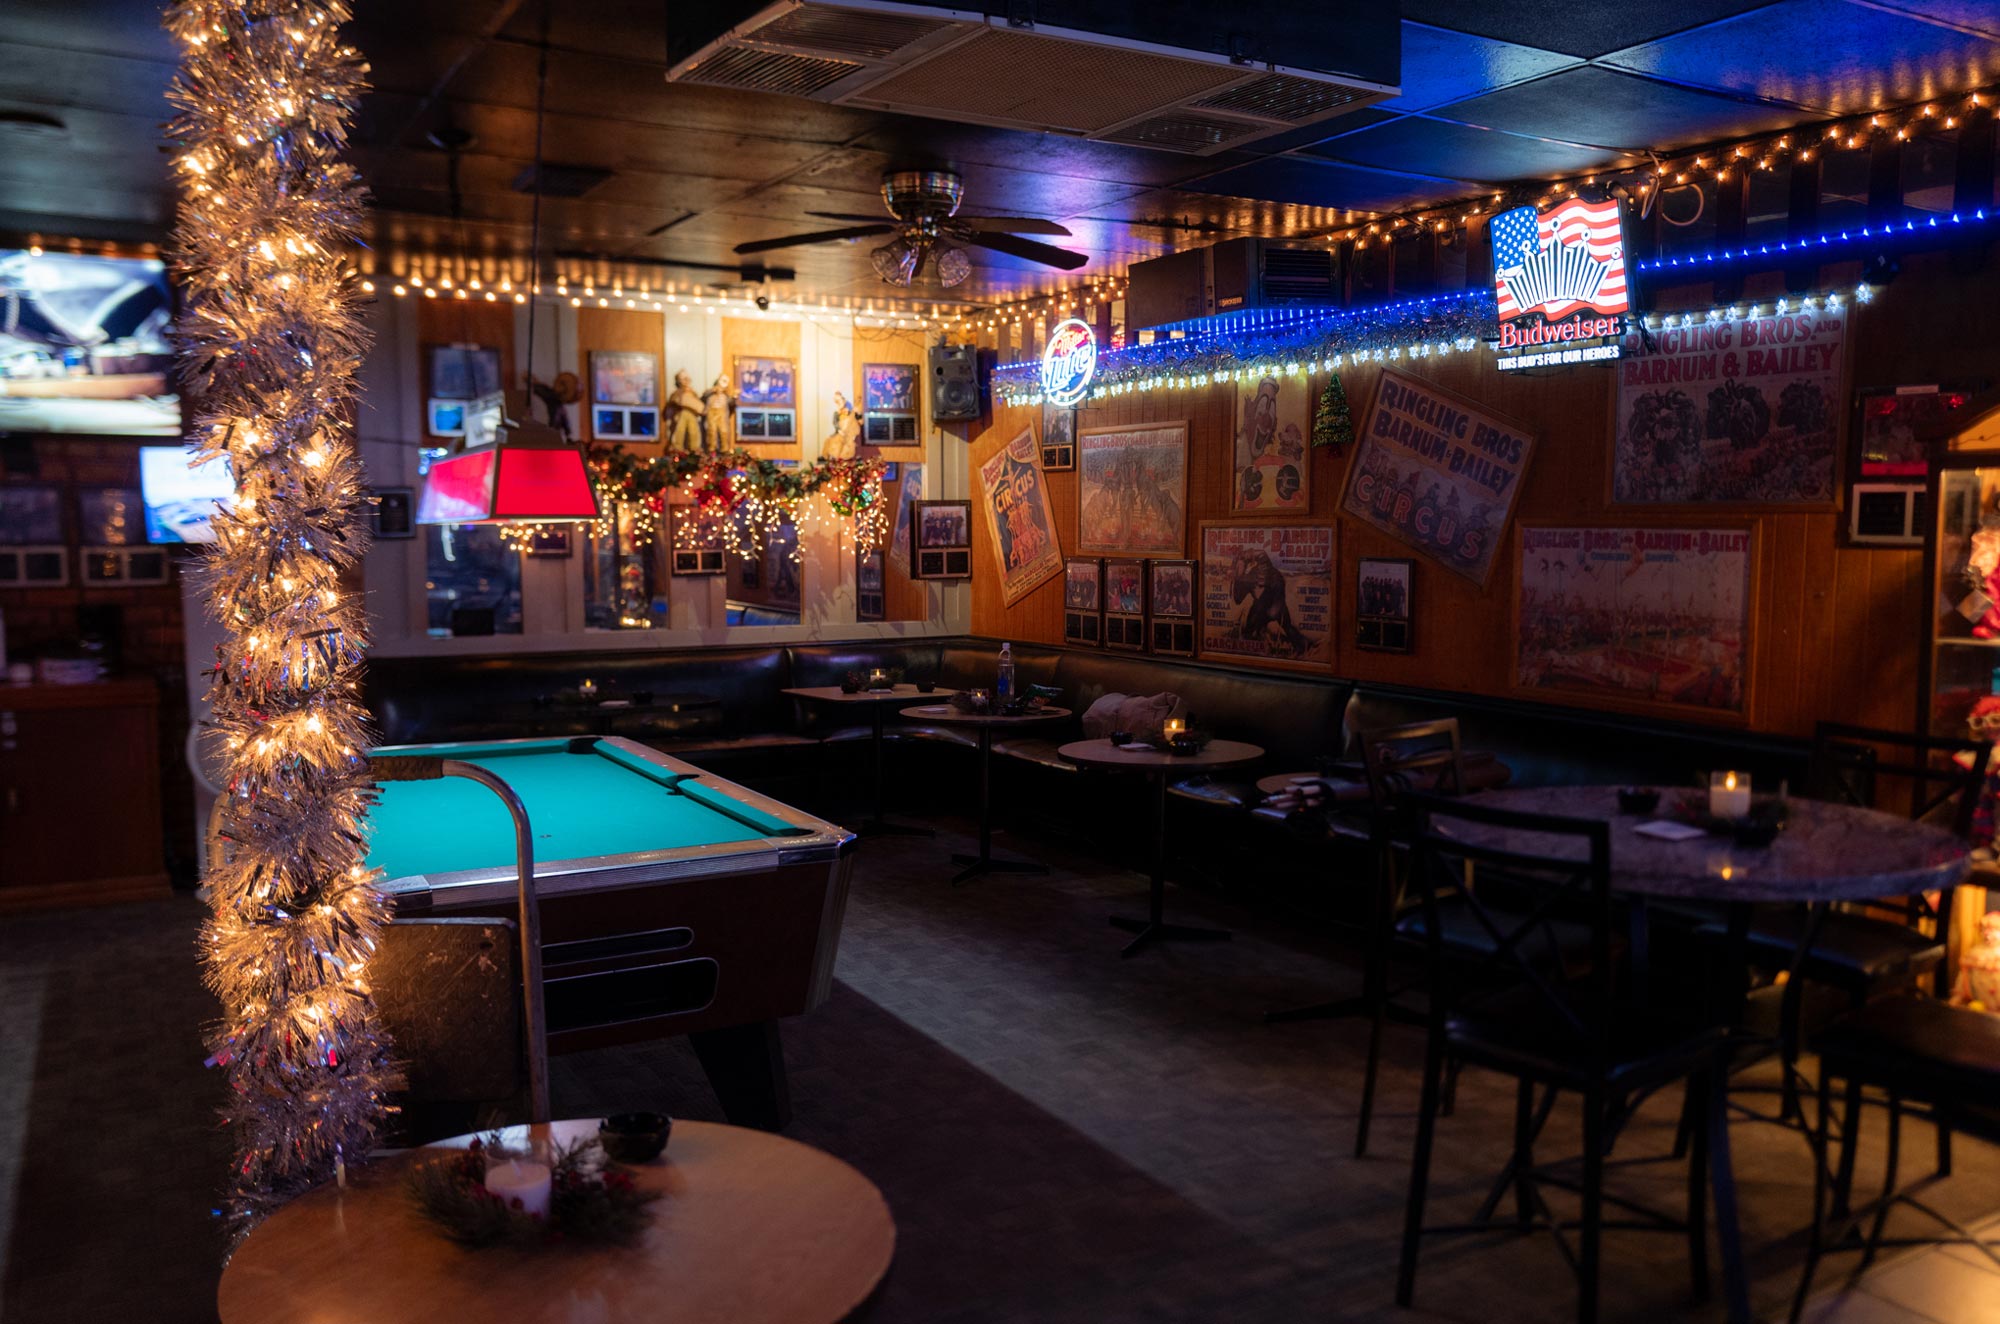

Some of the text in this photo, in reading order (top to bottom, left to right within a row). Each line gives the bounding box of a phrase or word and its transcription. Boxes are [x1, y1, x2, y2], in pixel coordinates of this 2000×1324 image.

[1814, 320, 1841, 334] AND
[1497, 345, 1619, 370] THIS BUD'S FOR OUR HEROES
[1624, 342, 1840, 386] BARNUM & BAILEY
[1379, 379, 1523, 465] RINGLING BROS
[1372, 409, 1449, 464] BARNUM
[1448, 445, 1516, 497] BAILEY
[1357, 475, 1483, 559] CIRCUS
[1207, 530, 1264, 552] RINGLING
[1271, 530, 1329, 552] BARNUM
[1286, 545, 1329, 559] BAILEY
[1699, 531, 1750, 555] BAILEY
